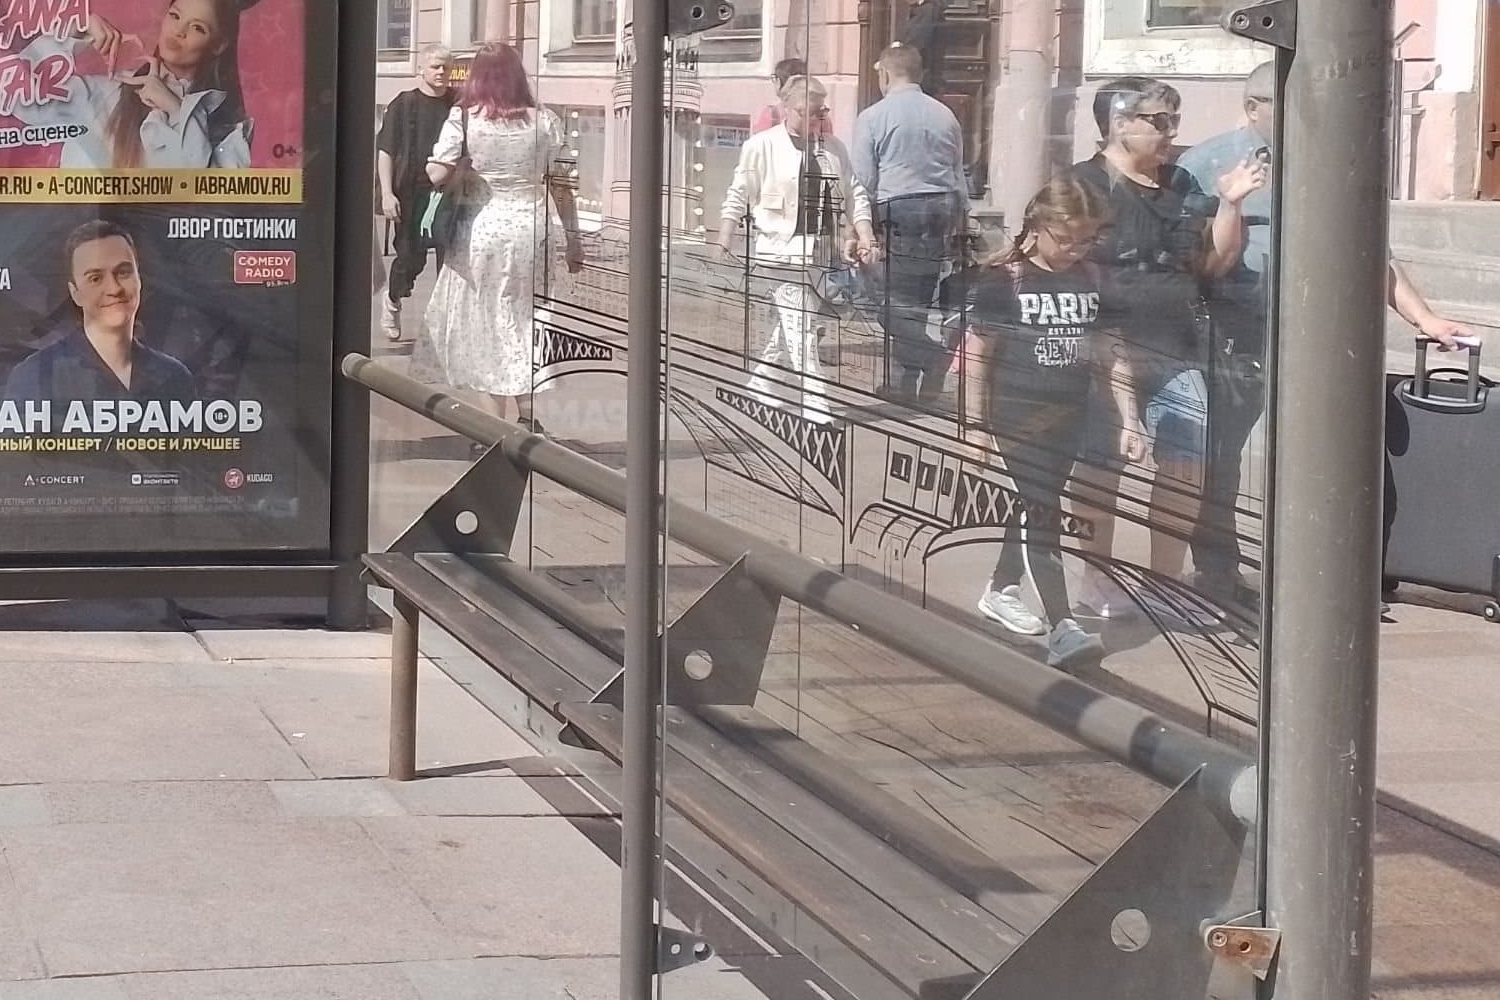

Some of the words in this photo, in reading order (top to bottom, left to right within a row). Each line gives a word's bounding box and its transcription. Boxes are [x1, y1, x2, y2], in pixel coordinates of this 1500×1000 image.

[24, 124, 89, 143] сцене»
[49, 176, 173, 195] A-CONCERT.SHOW
[194, 176, 291, 195] IABRAMOV.RU
[167, 218, 210, 238] ДВОР
[214, 218, 296, 239] ГОСТИНКИ
[238, 256, 291, 266] COMEDY
[245, 269, 284, 278] RADIO
[1019, 292, 1100, 325] PARIS
[62, 400, 263, 433] АБРАМОВ
[36, 438, 101, 452] КОНЦЕРТ
[116, 438, 166, 450] НОВОЕ
[169, 438, 179, 450] И
[182, 438, 240, 451] ЛУЧШЕЕ
